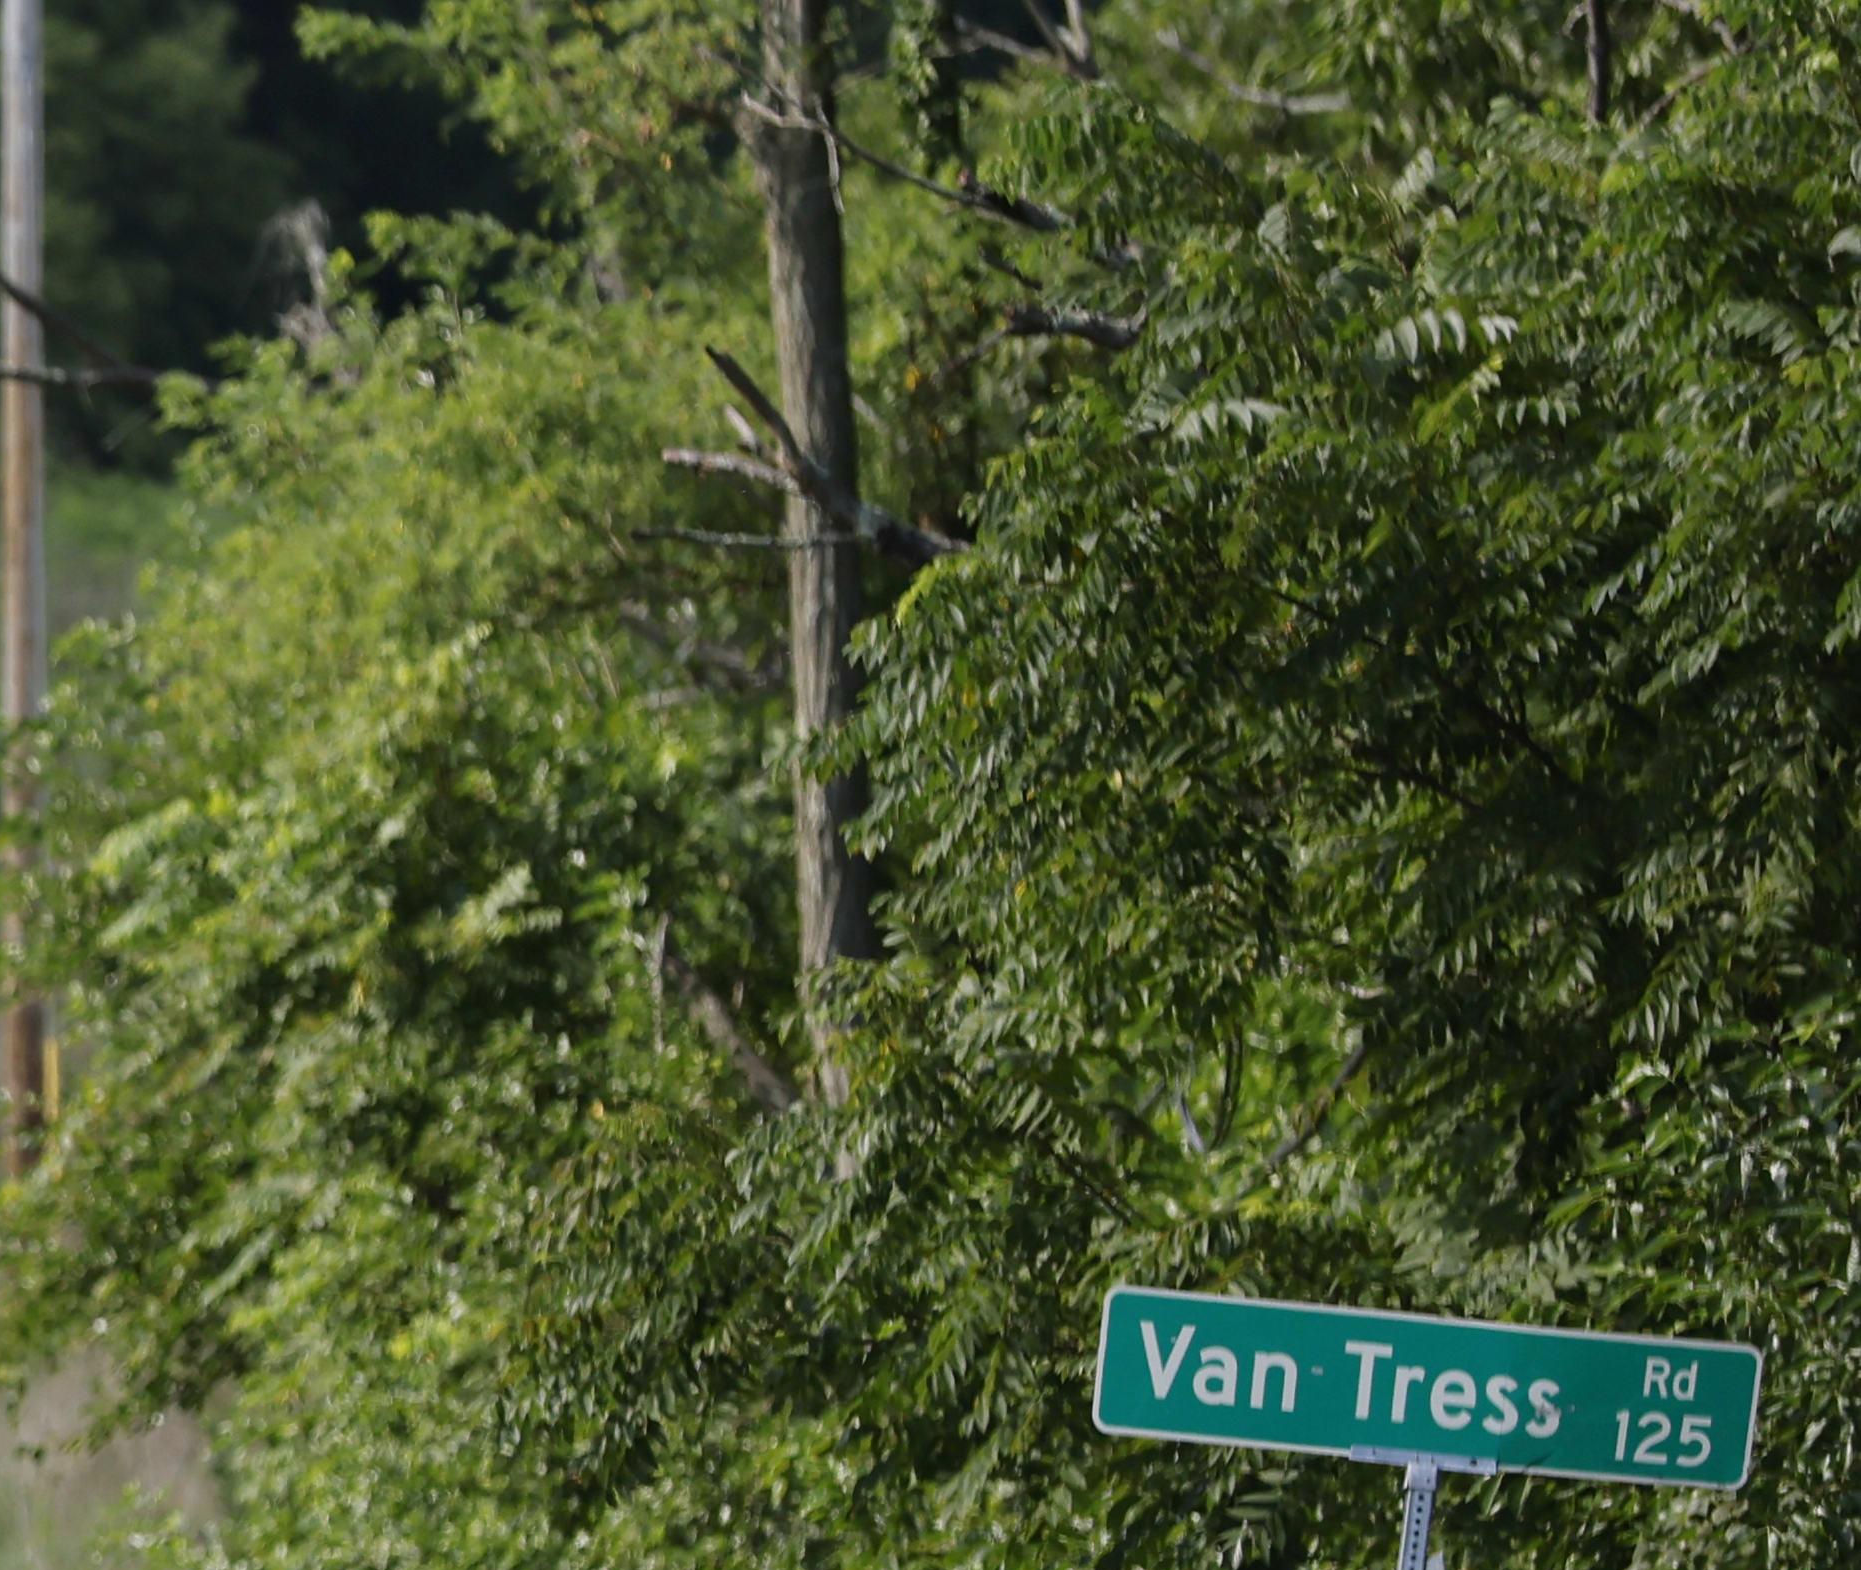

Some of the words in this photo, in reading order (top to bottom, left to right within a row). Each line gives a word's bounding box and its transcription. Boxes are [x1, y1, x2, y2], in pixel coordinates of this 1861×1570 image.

[1139, 1319, 1299, 1414] Van
[1344, 1339, 1562, 1439] Tress
[1642, 1355, 1700, 1402] Rd
[1613, 1408, 1713, 1468] 125
